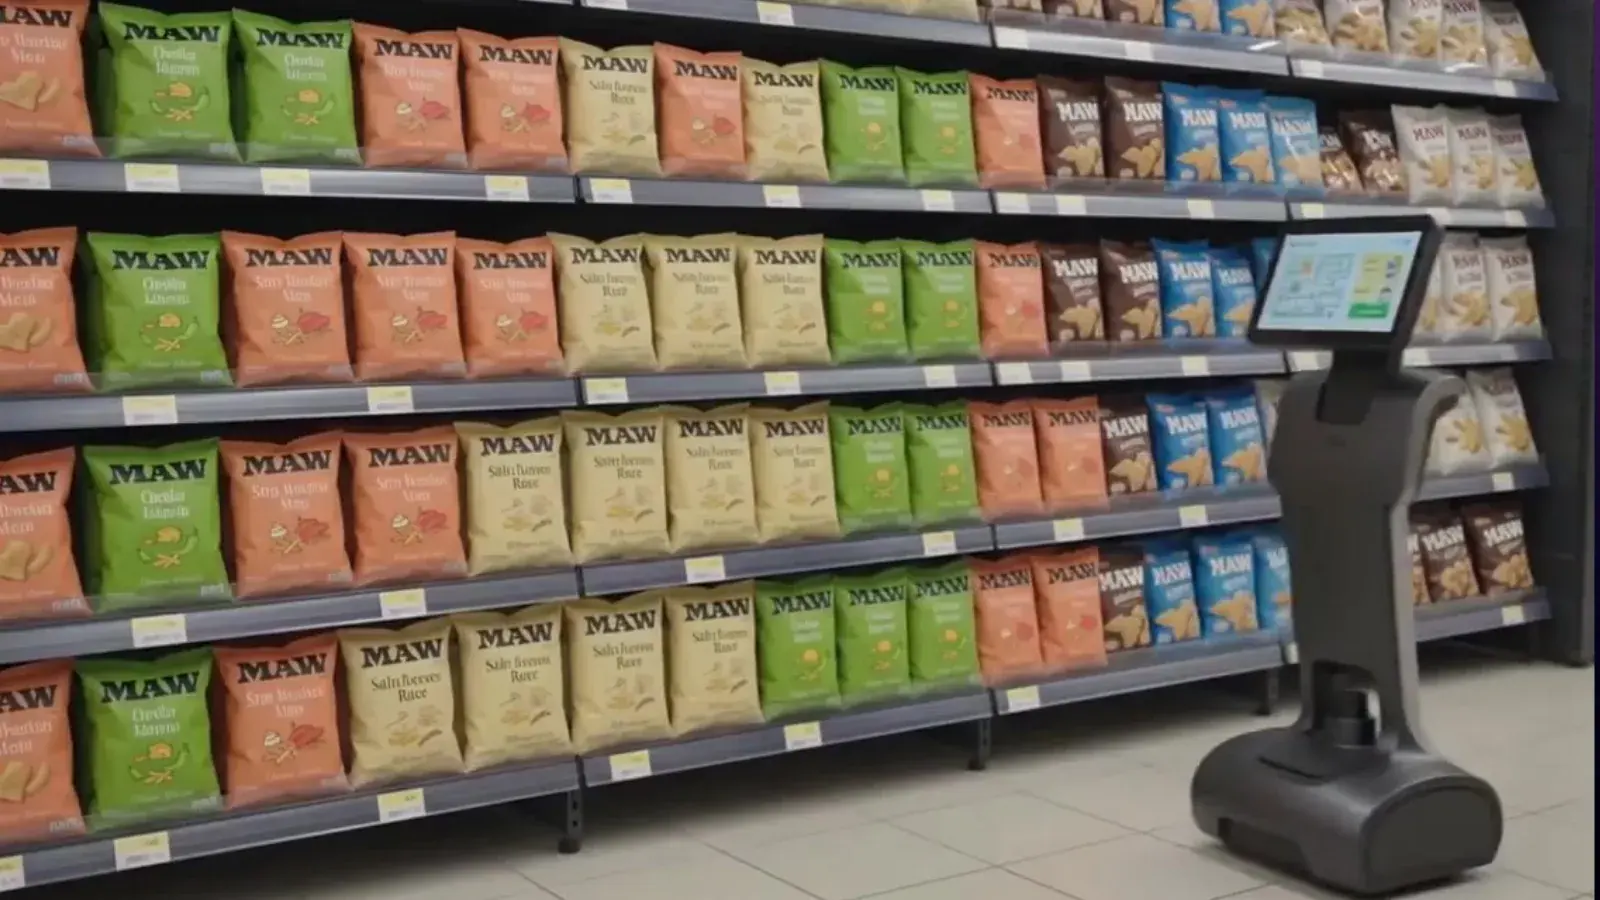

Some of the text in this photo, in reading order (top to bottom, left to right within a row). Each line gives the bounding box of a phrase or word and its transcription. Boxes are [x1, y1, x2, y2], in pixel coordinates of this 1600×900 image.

[0, 6, 72, 28] AW
[123, 22, 221, 43] MAW
[256, 28, 345, 48] MAW
[374, 39, 453, 60] MAW
[479, 44, 553, 66] MAW
[580, 54, 649, 74] MAW
[674, 60, 738, 81] MAW
[753, 71, 814, 88] MAW
[838, 73, 896, 92] MAW
[913, 80, 968, 96] MAW
[1056, 101, 1100, 122] MAW
[1181, 108, 1217, 127] MAW
[112, 249, 211, 271] MAW
[245, 247, 333, 267] MAW
[367, 247, 449, 267] MAW
[473, 251, 547, 270] MAW
[571, 247, 640, 264] MAW
[664, 247, 731, 264] MAW
[755, 249, 816, 266] MAW
[841, 252, 898, 268] MAW
[916, 251, 973, 267] MAW
[988, 252, 1039, 268] MAW
[1053, 257, 1099, 278] MAW
[1170, 261, 1211, 282] MAW
[764, 418, 825, 438] MAW
[847, 416, 903, 436] MAW
[916, 413, 967, 432] MAW
[983, 410, 1032, 428] MAW
[1050, 409, 1097, 426] MAW
[1102, 414, 1148, 439] MAW
[1166, 412, 1207, 435] MAW
[584, 426, 657, 446] MAW
[678, 418, 744, 439] MAW
[368, 443, 452, 468] MAW
[480, 434, 555, 456] MAW
[109, 458, 207, 485] MAW
[242, 449, 333, 476] MAW
[1046, 561, 1099, 585] MAW
[1152, 561, 1193, 585] MAW
[1210, 554, 1251, 576] MAW
[915, 576, 968, 598] MAW
[979, 568, 1032, 590] MAW
[1099, 565, 1144, 591] MAW
[771, 590, 831, 616] MAW
[849, 586, 905, 606] MAW
[684, 598, 749, 622] MAW
[584, 609, 656, 636] MAW
[477, 622, 553, 649] MAW
[361, 638, 443, 668] MAW
[237, 653, 327, 684] MAW
[102, 672, 199, 703] MAW
